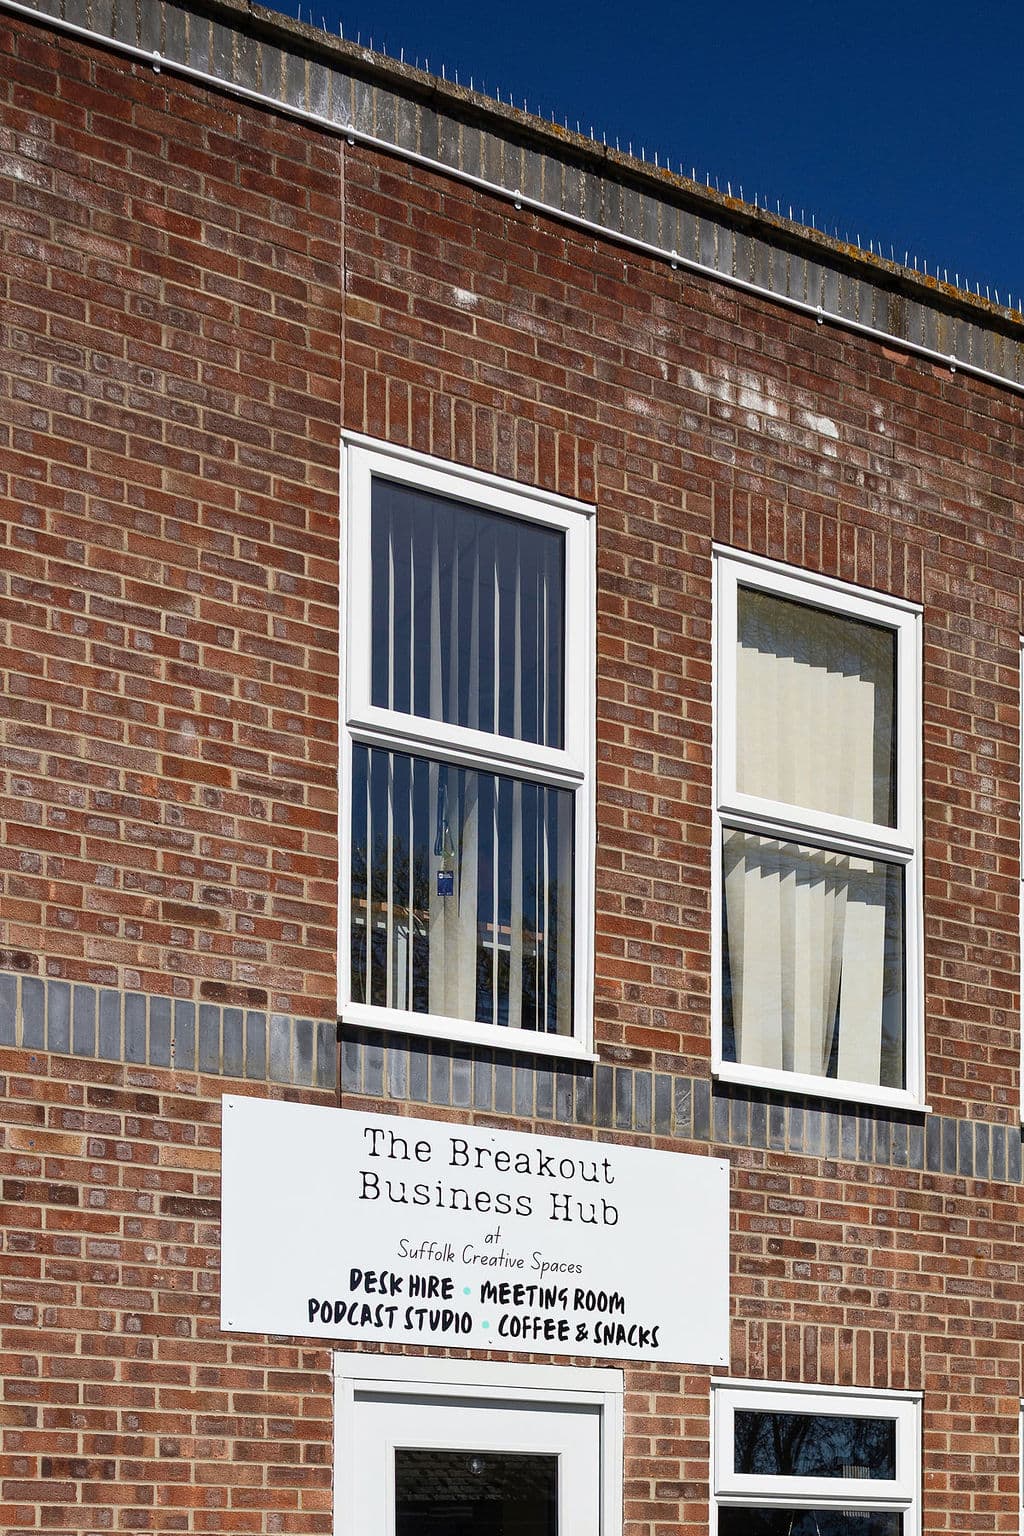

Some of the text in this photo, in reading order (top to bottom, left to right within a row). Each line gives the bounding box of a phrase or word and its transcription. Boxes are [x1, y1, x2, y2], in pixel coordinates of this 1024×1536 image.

[364, 1128, 614, 1185] The Breakout
[359, 1171, 619, 1226] Business Hub
[397, 1238, 583, 1279] Suffolk Creative Spaces
[485, 1226, 502, 1244] at
[350, 1268, 625, 1315] DESK HIRE MEETING ROOM
[308, 1297, 660, 1349] PODCAST STUDIO COFFEE & SNACKS
